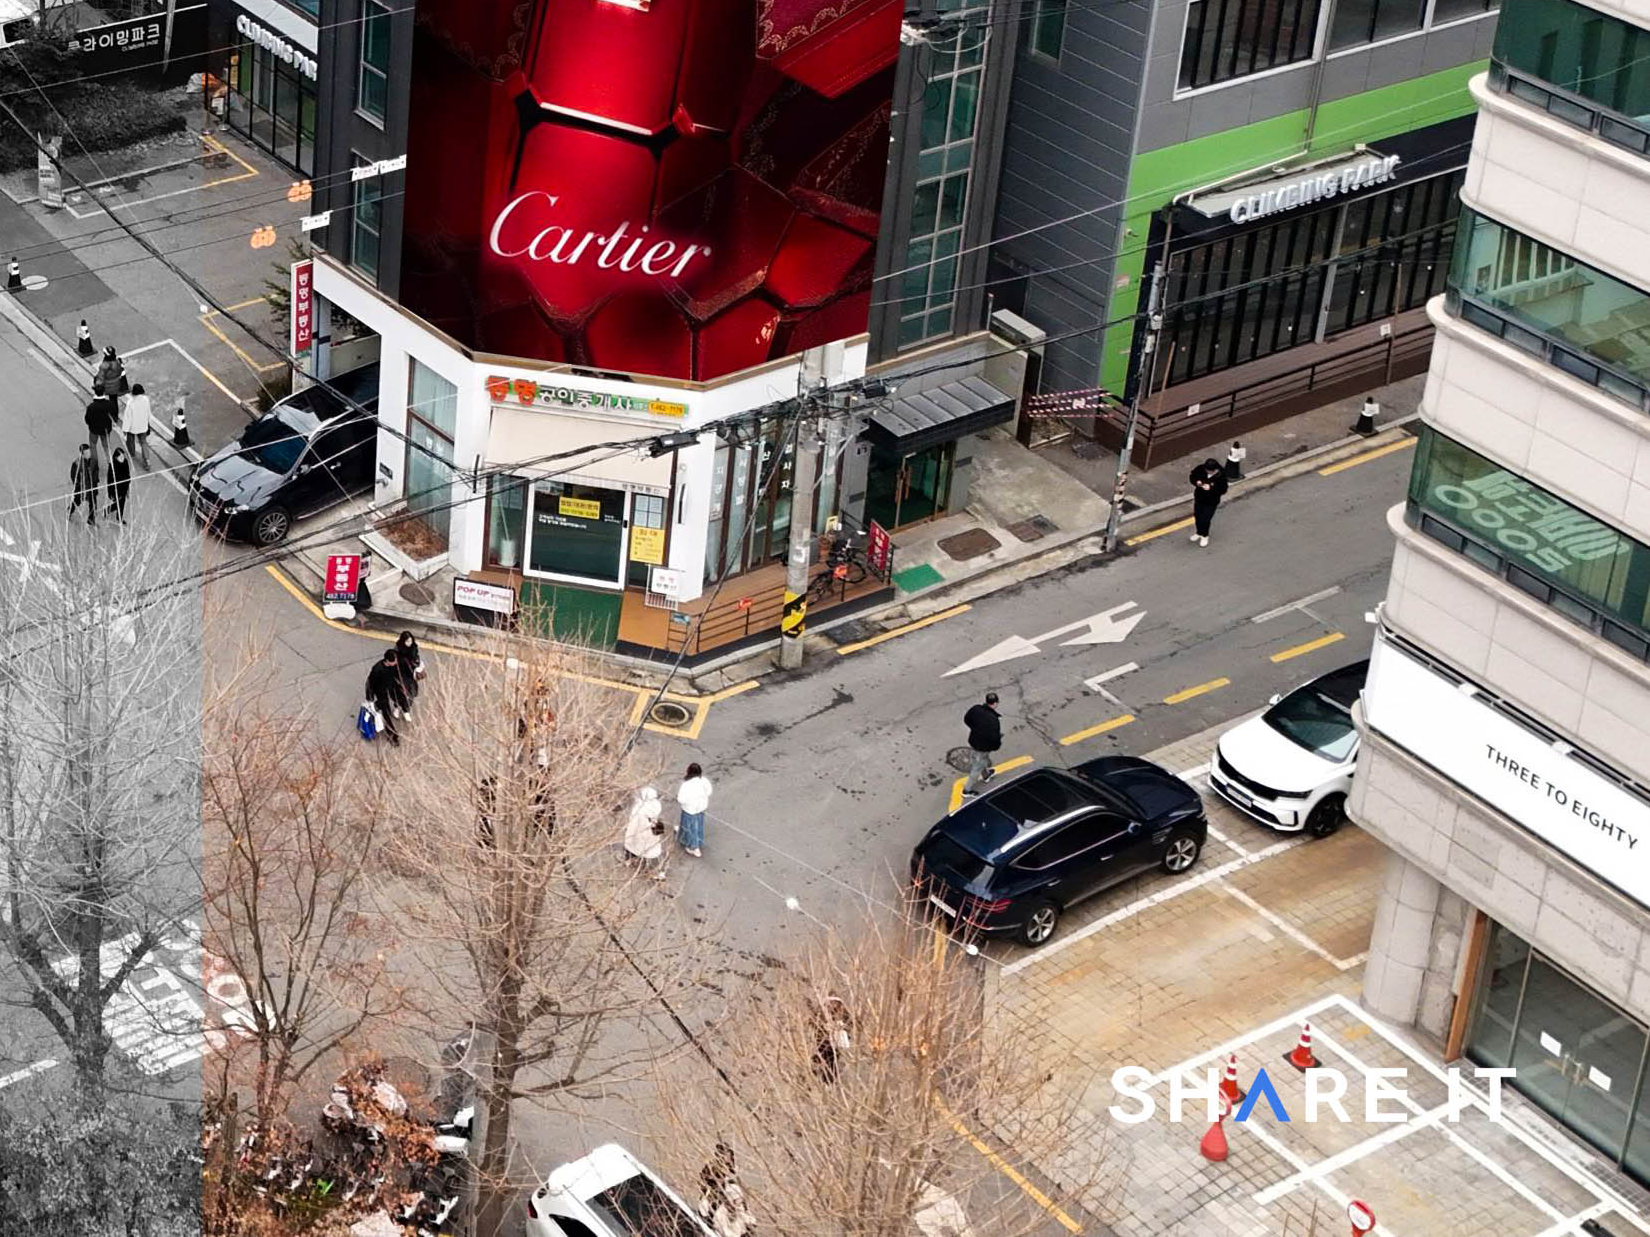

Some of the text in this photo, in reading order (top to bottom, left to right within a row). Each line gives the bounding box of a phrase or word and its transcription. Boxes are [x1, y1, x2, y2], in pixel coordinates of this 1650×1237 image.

[1230, 154, 1402, 225] CLIMBING PARK
[489, 191, 712, 277] Cartier
[1485, 743, 1638, 850] THREE TO EIGHTY
